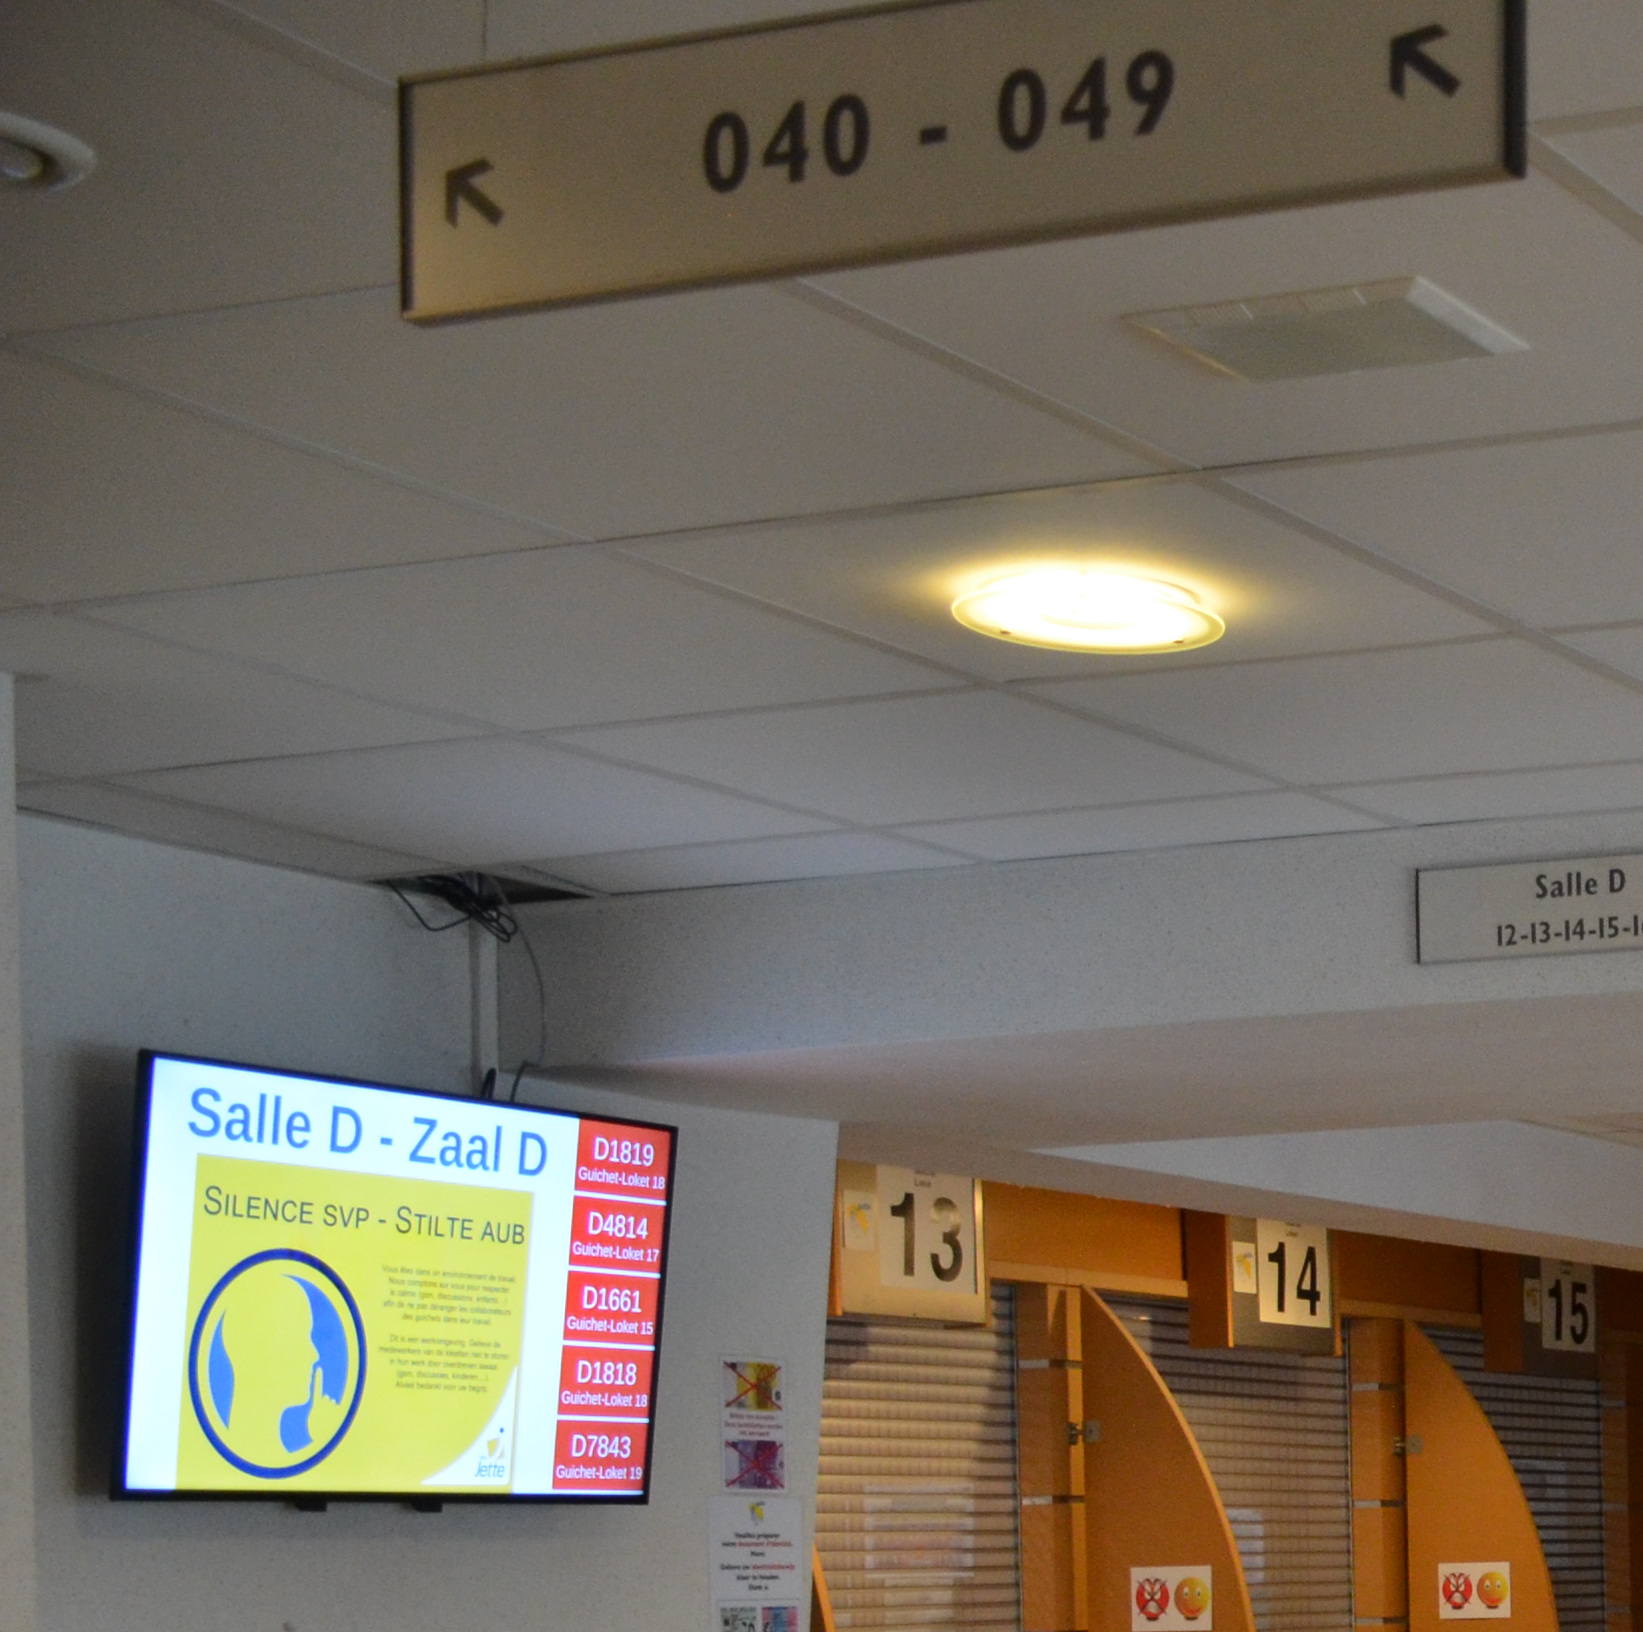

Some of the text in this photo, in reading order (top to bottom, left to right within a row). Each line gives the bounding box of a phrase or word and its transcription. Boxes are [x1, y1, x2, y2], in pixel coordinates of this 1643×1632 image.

[702, 94, 870, 193] 040
[996, 50, 1176, 152] 049
[1535, 872, 1599, 899] Salle
[1609, 869, 1627, 894] D
[187, 1086, 311, 1150] Salle
[329, 1105, 363, 1155] D
[409, 1115, 503, 1173] Zaal
[518, 1130, 548, 1177] D
[594, 1136, 654, 1167] D1819
[578, 1166, 665, 1190] Guichet-Loket 18
[203, 1185, 314, 1224] SILENCE
[323, 1203, 370, 1229] SVP
[395, 1205, 473, 1240] STILTE
[480, 1220, 525, 1245] AUB
[588, 1211, 648, 1239] D4814
[889, 1191, 963, 1283] 13
[572, 1241, 660, 1262] Guichet-Loket 17
[1266, 1240, 1322, 1318] 14
[582, 1285, 642, 1313] D1661
[1548, 1276, 1589, 1347] 15
[566, 1315, 654, 1335] Guichet-Loket 15
[576, 1359, 637, 1385] D1818
[561, 1390, 648, 1408] Guichet-Loket 18
[571, 1433, 631, 1458] D7843
[555, 1464, 643, 1480] Guichet-Loket 19
